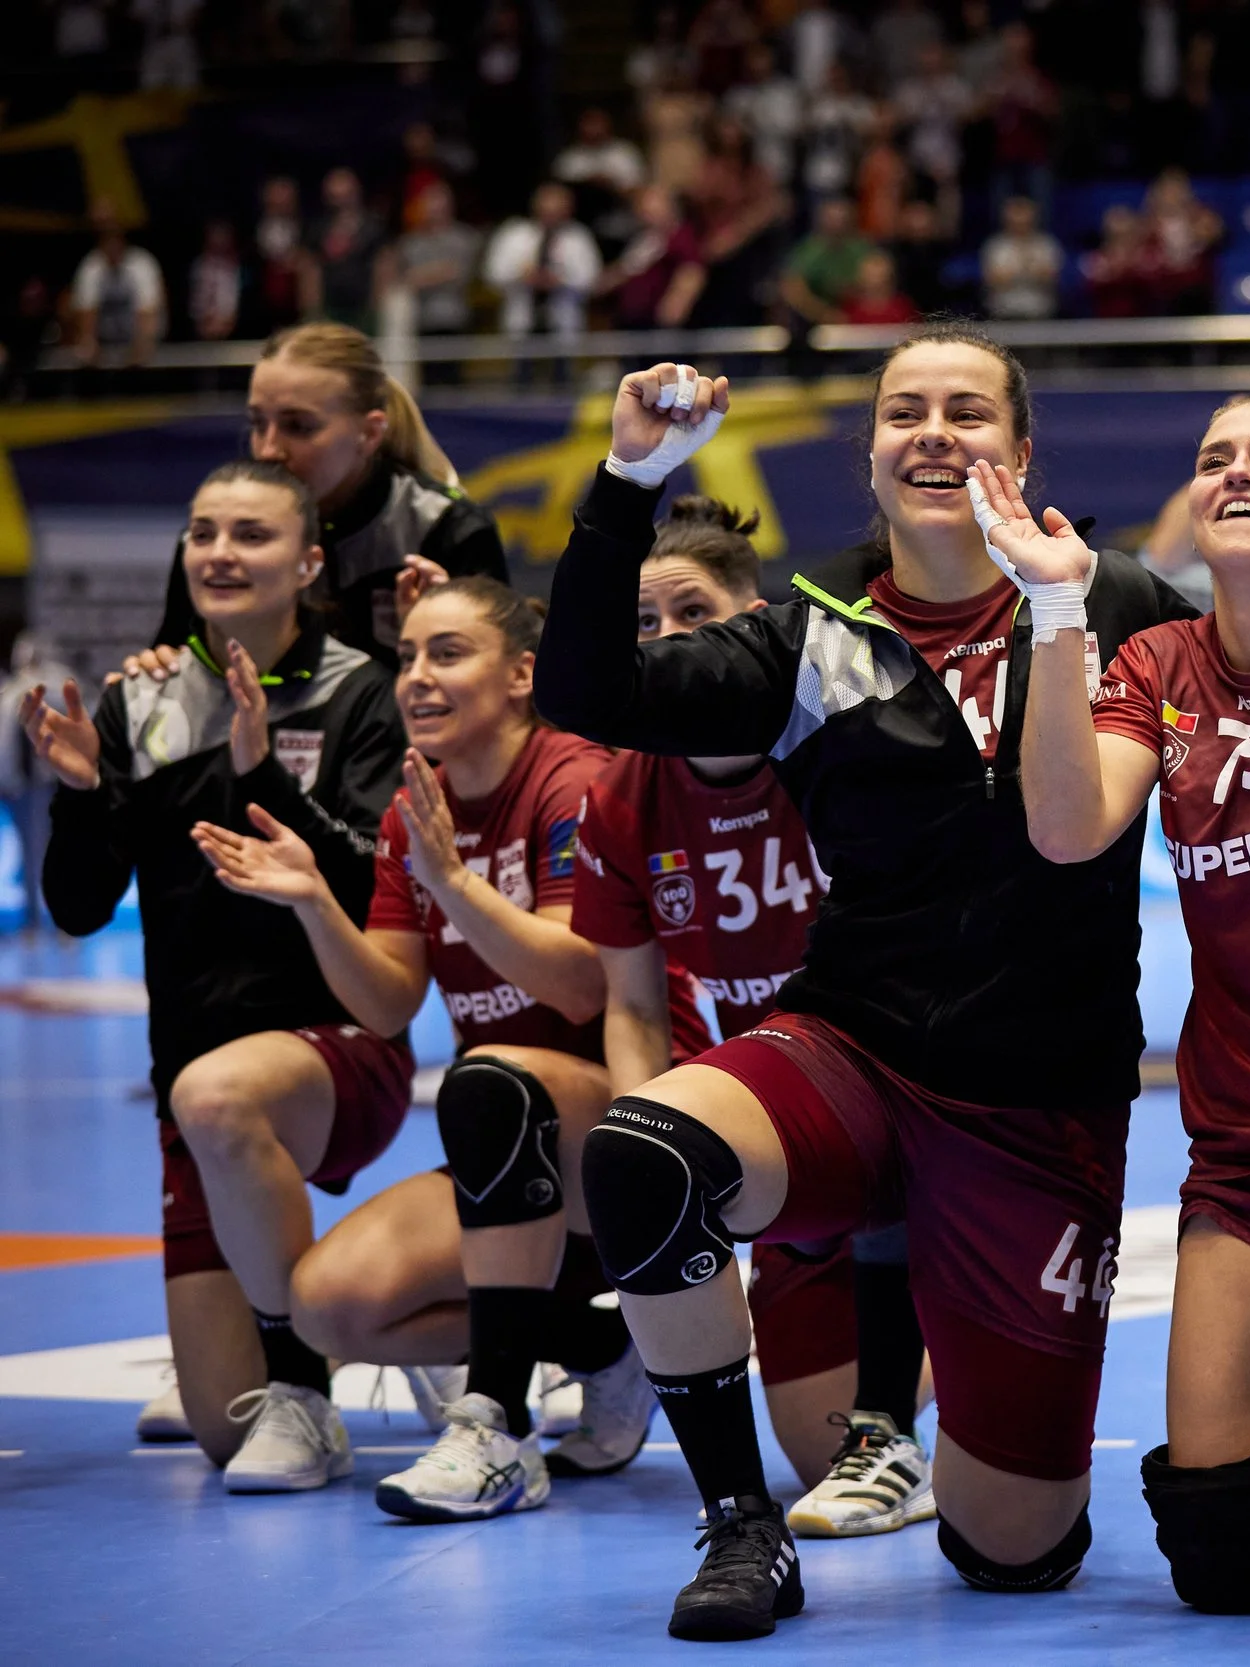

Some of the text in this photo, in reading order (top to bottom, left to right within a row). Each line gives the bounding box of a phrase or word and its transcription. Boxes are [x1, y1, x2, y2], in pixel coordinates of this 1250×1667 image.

[709, 808, 770, 834] Kempa
[662, 886, 688, 900] 100
[703, 837, 813, 932] 34
